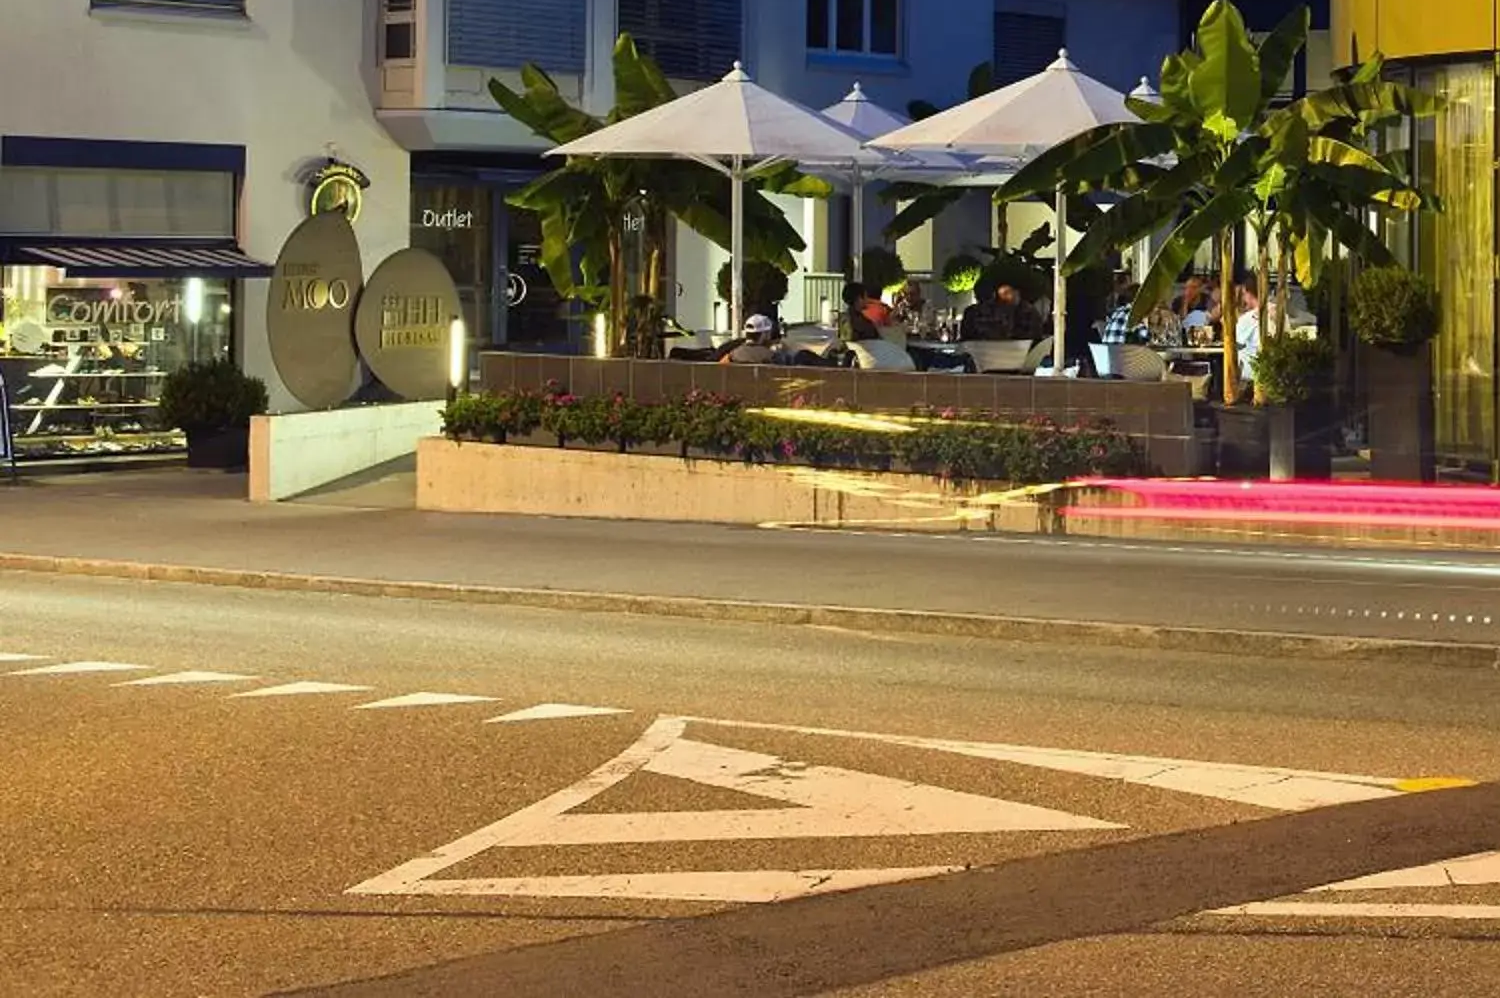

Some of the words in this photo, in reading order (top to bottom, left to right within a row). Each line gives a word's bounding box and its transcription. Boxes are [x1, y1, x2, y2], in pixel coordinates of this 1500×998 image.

[422, 208, 473, 230] Outlet
[49, 293, 182, 324] Comfort
[283, 278, 350, 310] MOO
